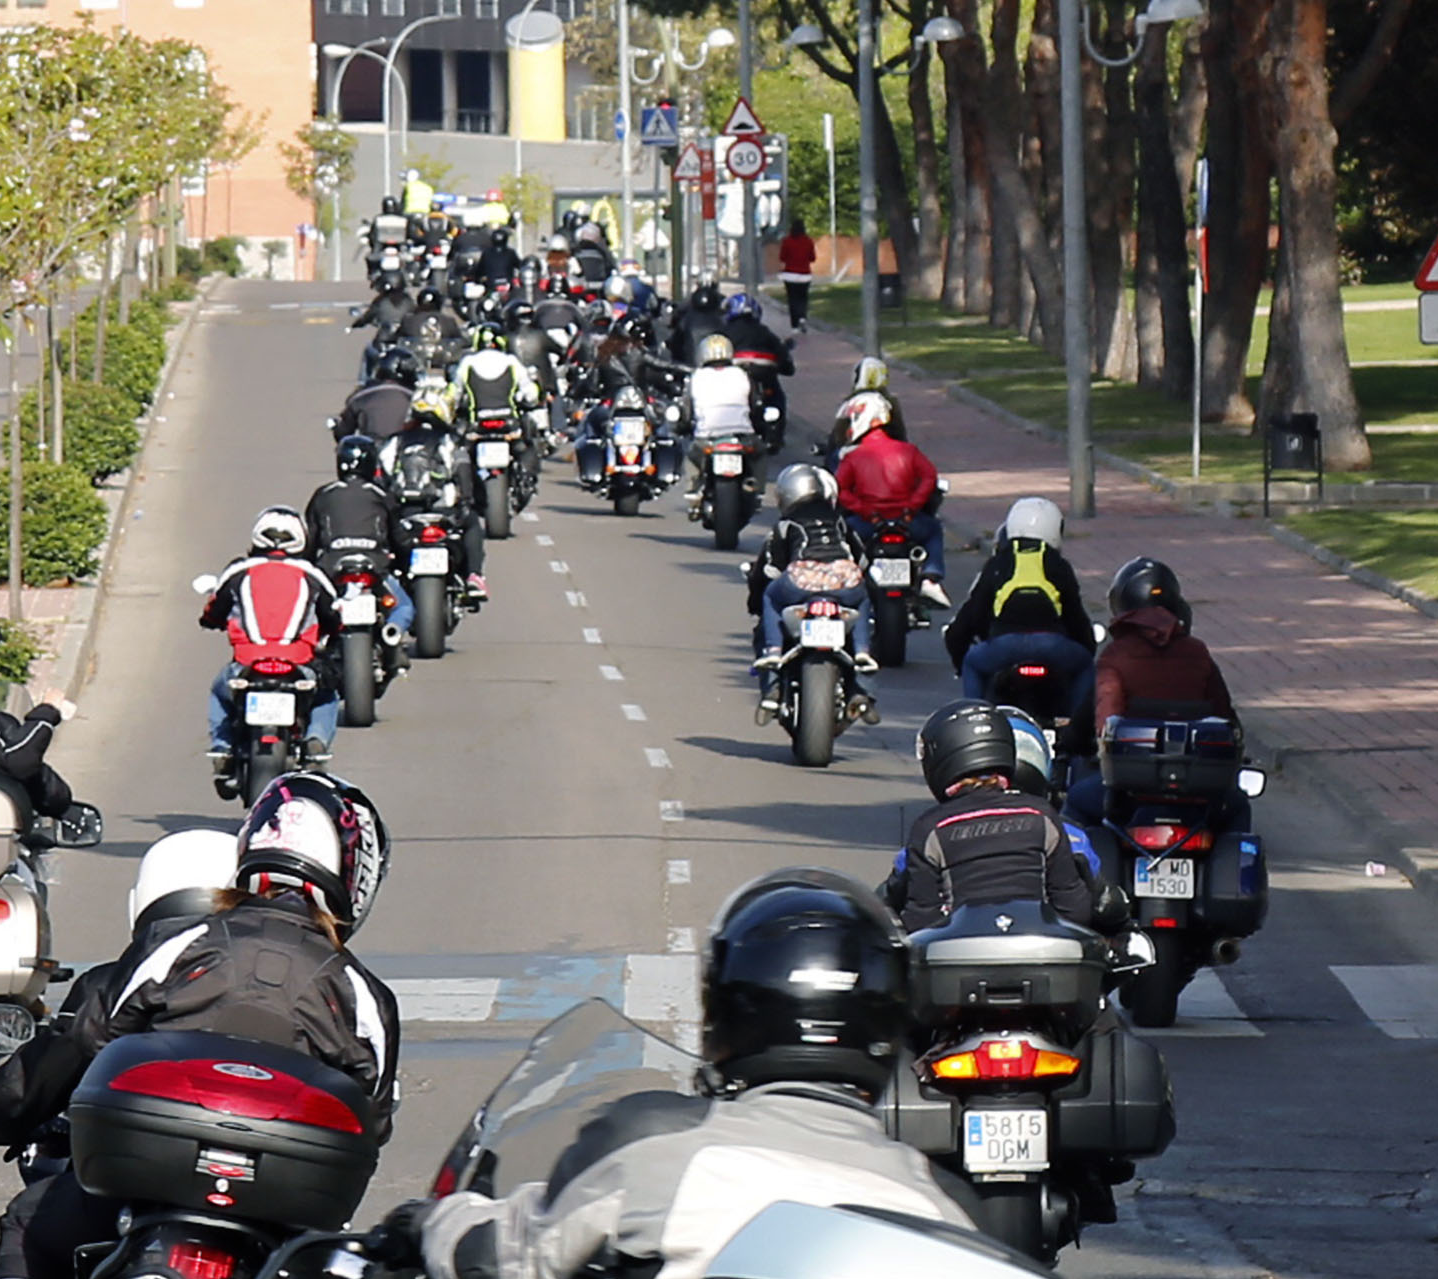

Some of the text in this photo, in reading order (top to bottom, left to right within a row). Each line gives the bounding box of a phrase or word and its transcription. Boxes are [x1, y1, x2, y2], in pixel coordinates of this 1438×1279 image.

[734, 151, 757, 166] 30
[1149, 878, 1188, 895] 1530
[984, 1113, 1042, 1137] 5815
[987, 1138, 1030, 1161] DGM
